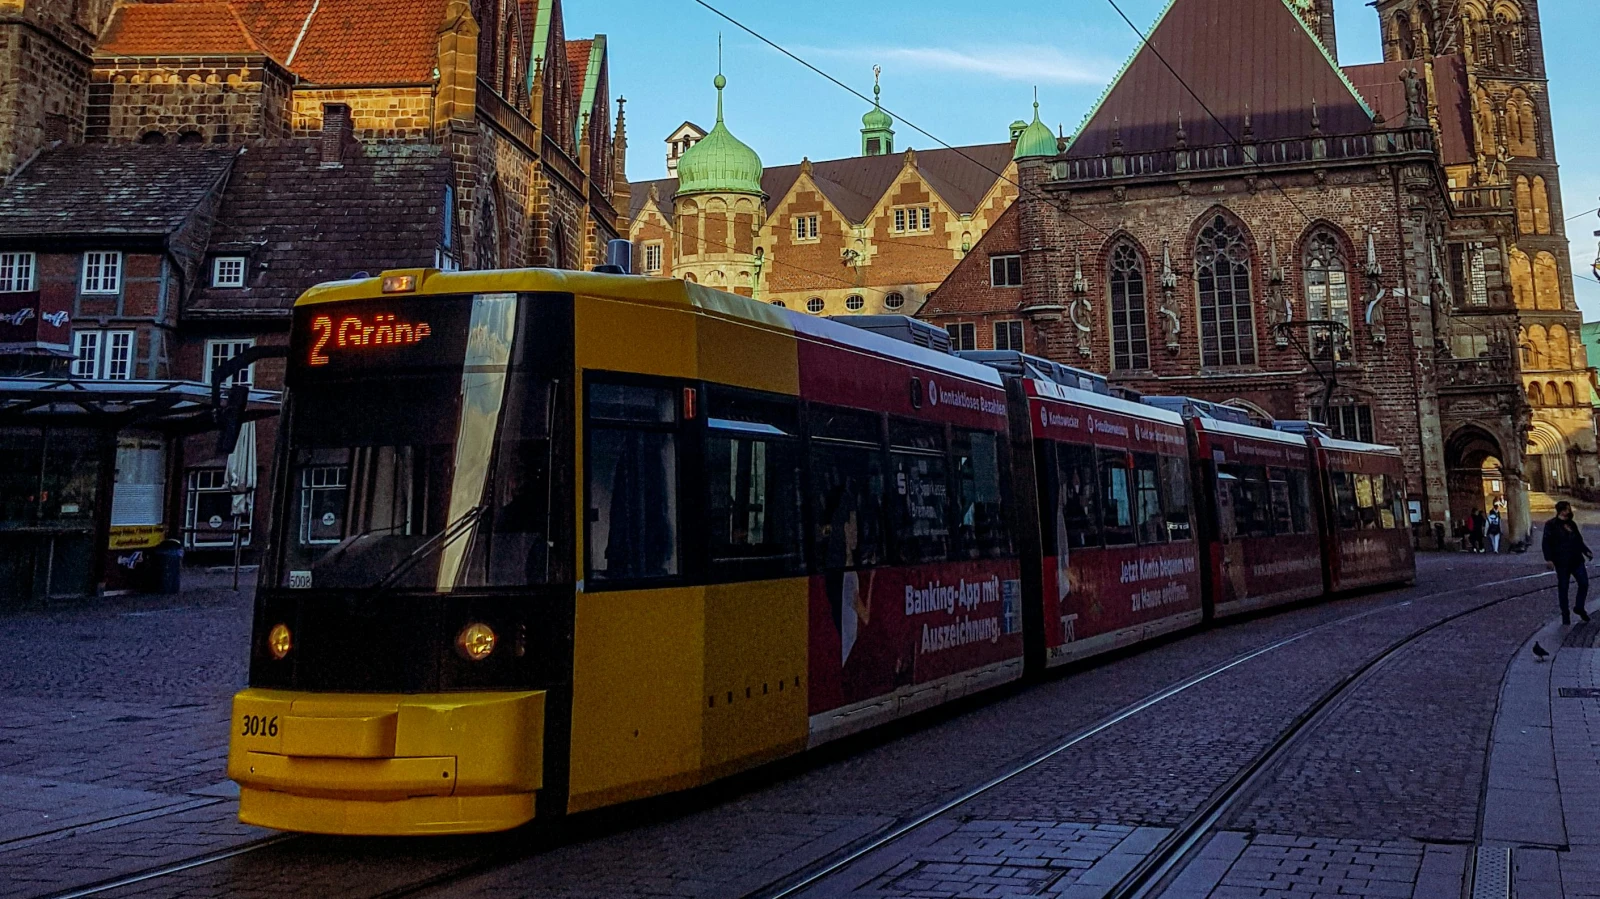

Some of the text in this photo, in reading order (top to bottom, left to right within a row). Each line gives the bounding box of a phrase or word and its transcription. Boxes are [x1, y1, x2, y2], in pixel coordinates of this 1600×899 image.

[310, 316, 332, 365] 2
[939, 386, 1006, 415] kontaktloses Bezahlen
[290, 574, 312, 588] 5008
[1120, 560, 1139, 584] Jetzt
[1139, 558, 1159, 580] Konto
[905, 578, 981, 615] Banking-App
[982, 574, 1000, 603] mit
[1131, 593, 1141, 612] zu
[241, 714, 279, 737] 3016
